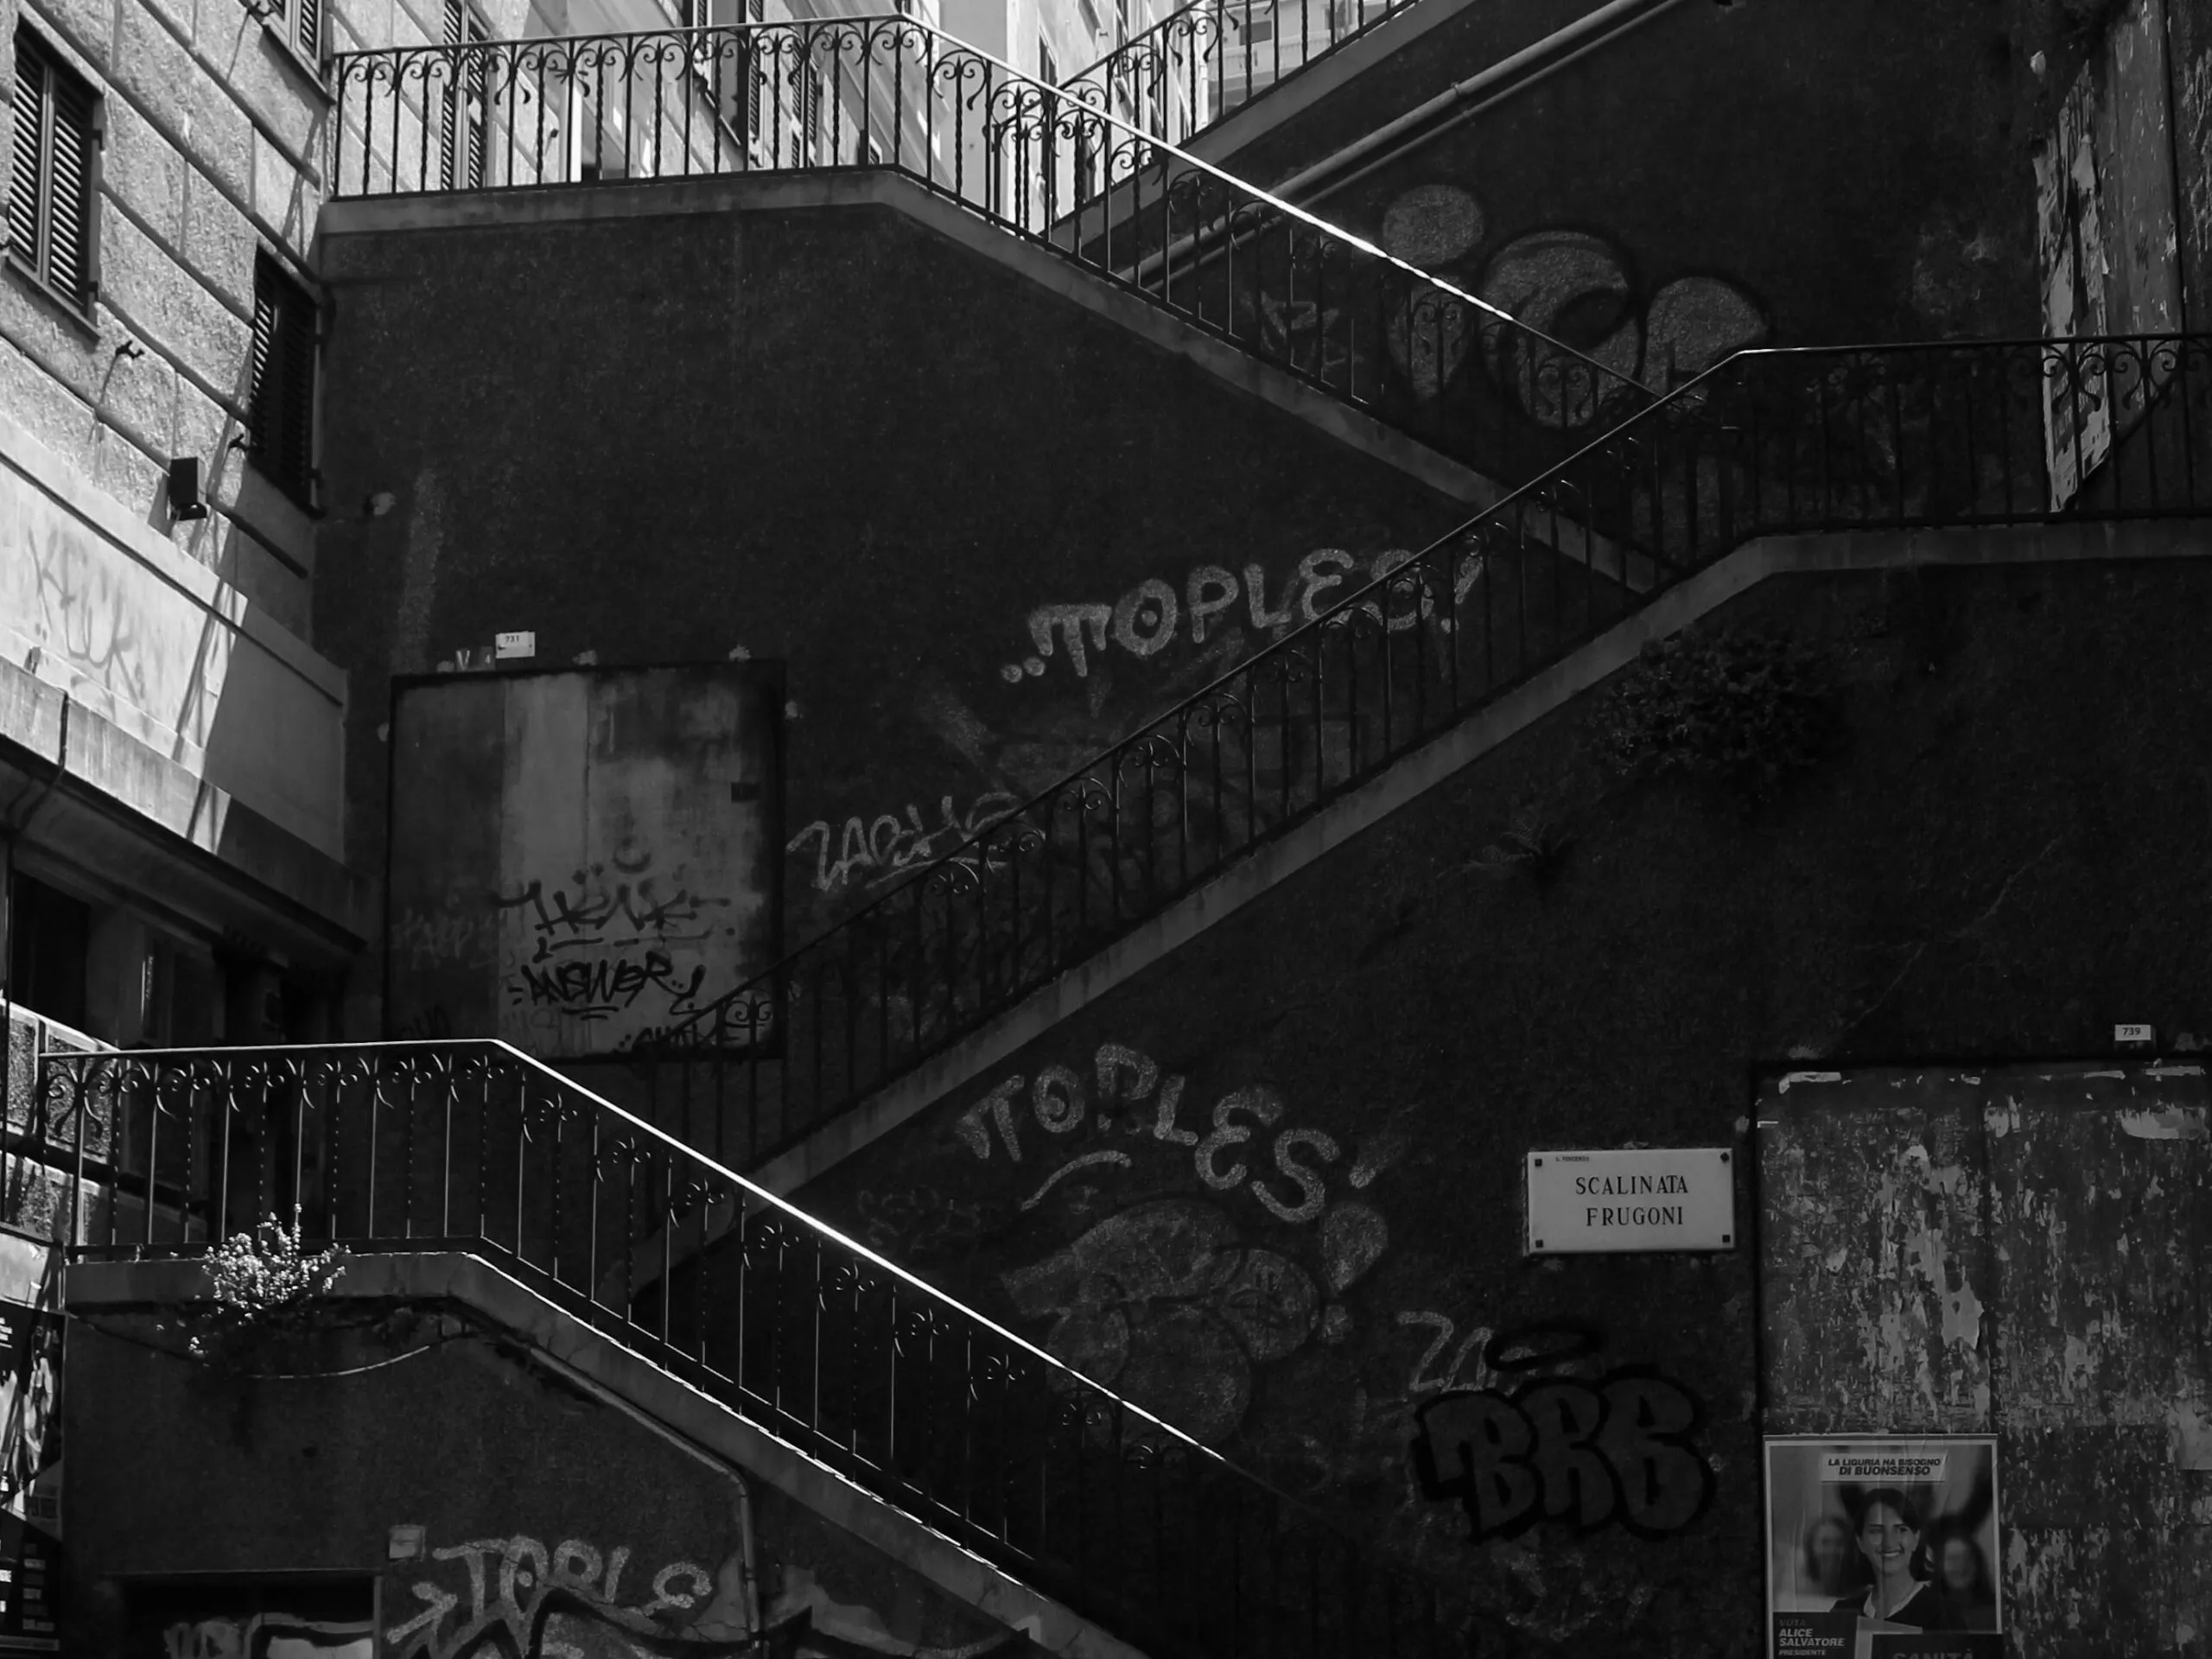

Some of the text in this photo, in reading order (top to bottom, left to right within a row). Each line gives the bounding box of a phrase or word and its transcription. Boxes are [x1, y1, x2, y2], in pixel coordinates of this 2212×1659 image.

[2122, 1027, 2141, 1035] 739
[1575, 1175, 1688, 1195] SCALINATA
[1586, 1206, 1684, 1226] FRUGONI
[1839, 1466, 1931, 1476] DI BUONSENSO
[1778, 1628, 1814, 1637] ALICE
[1779, 1637, 1846, 1647] SALVATORE
